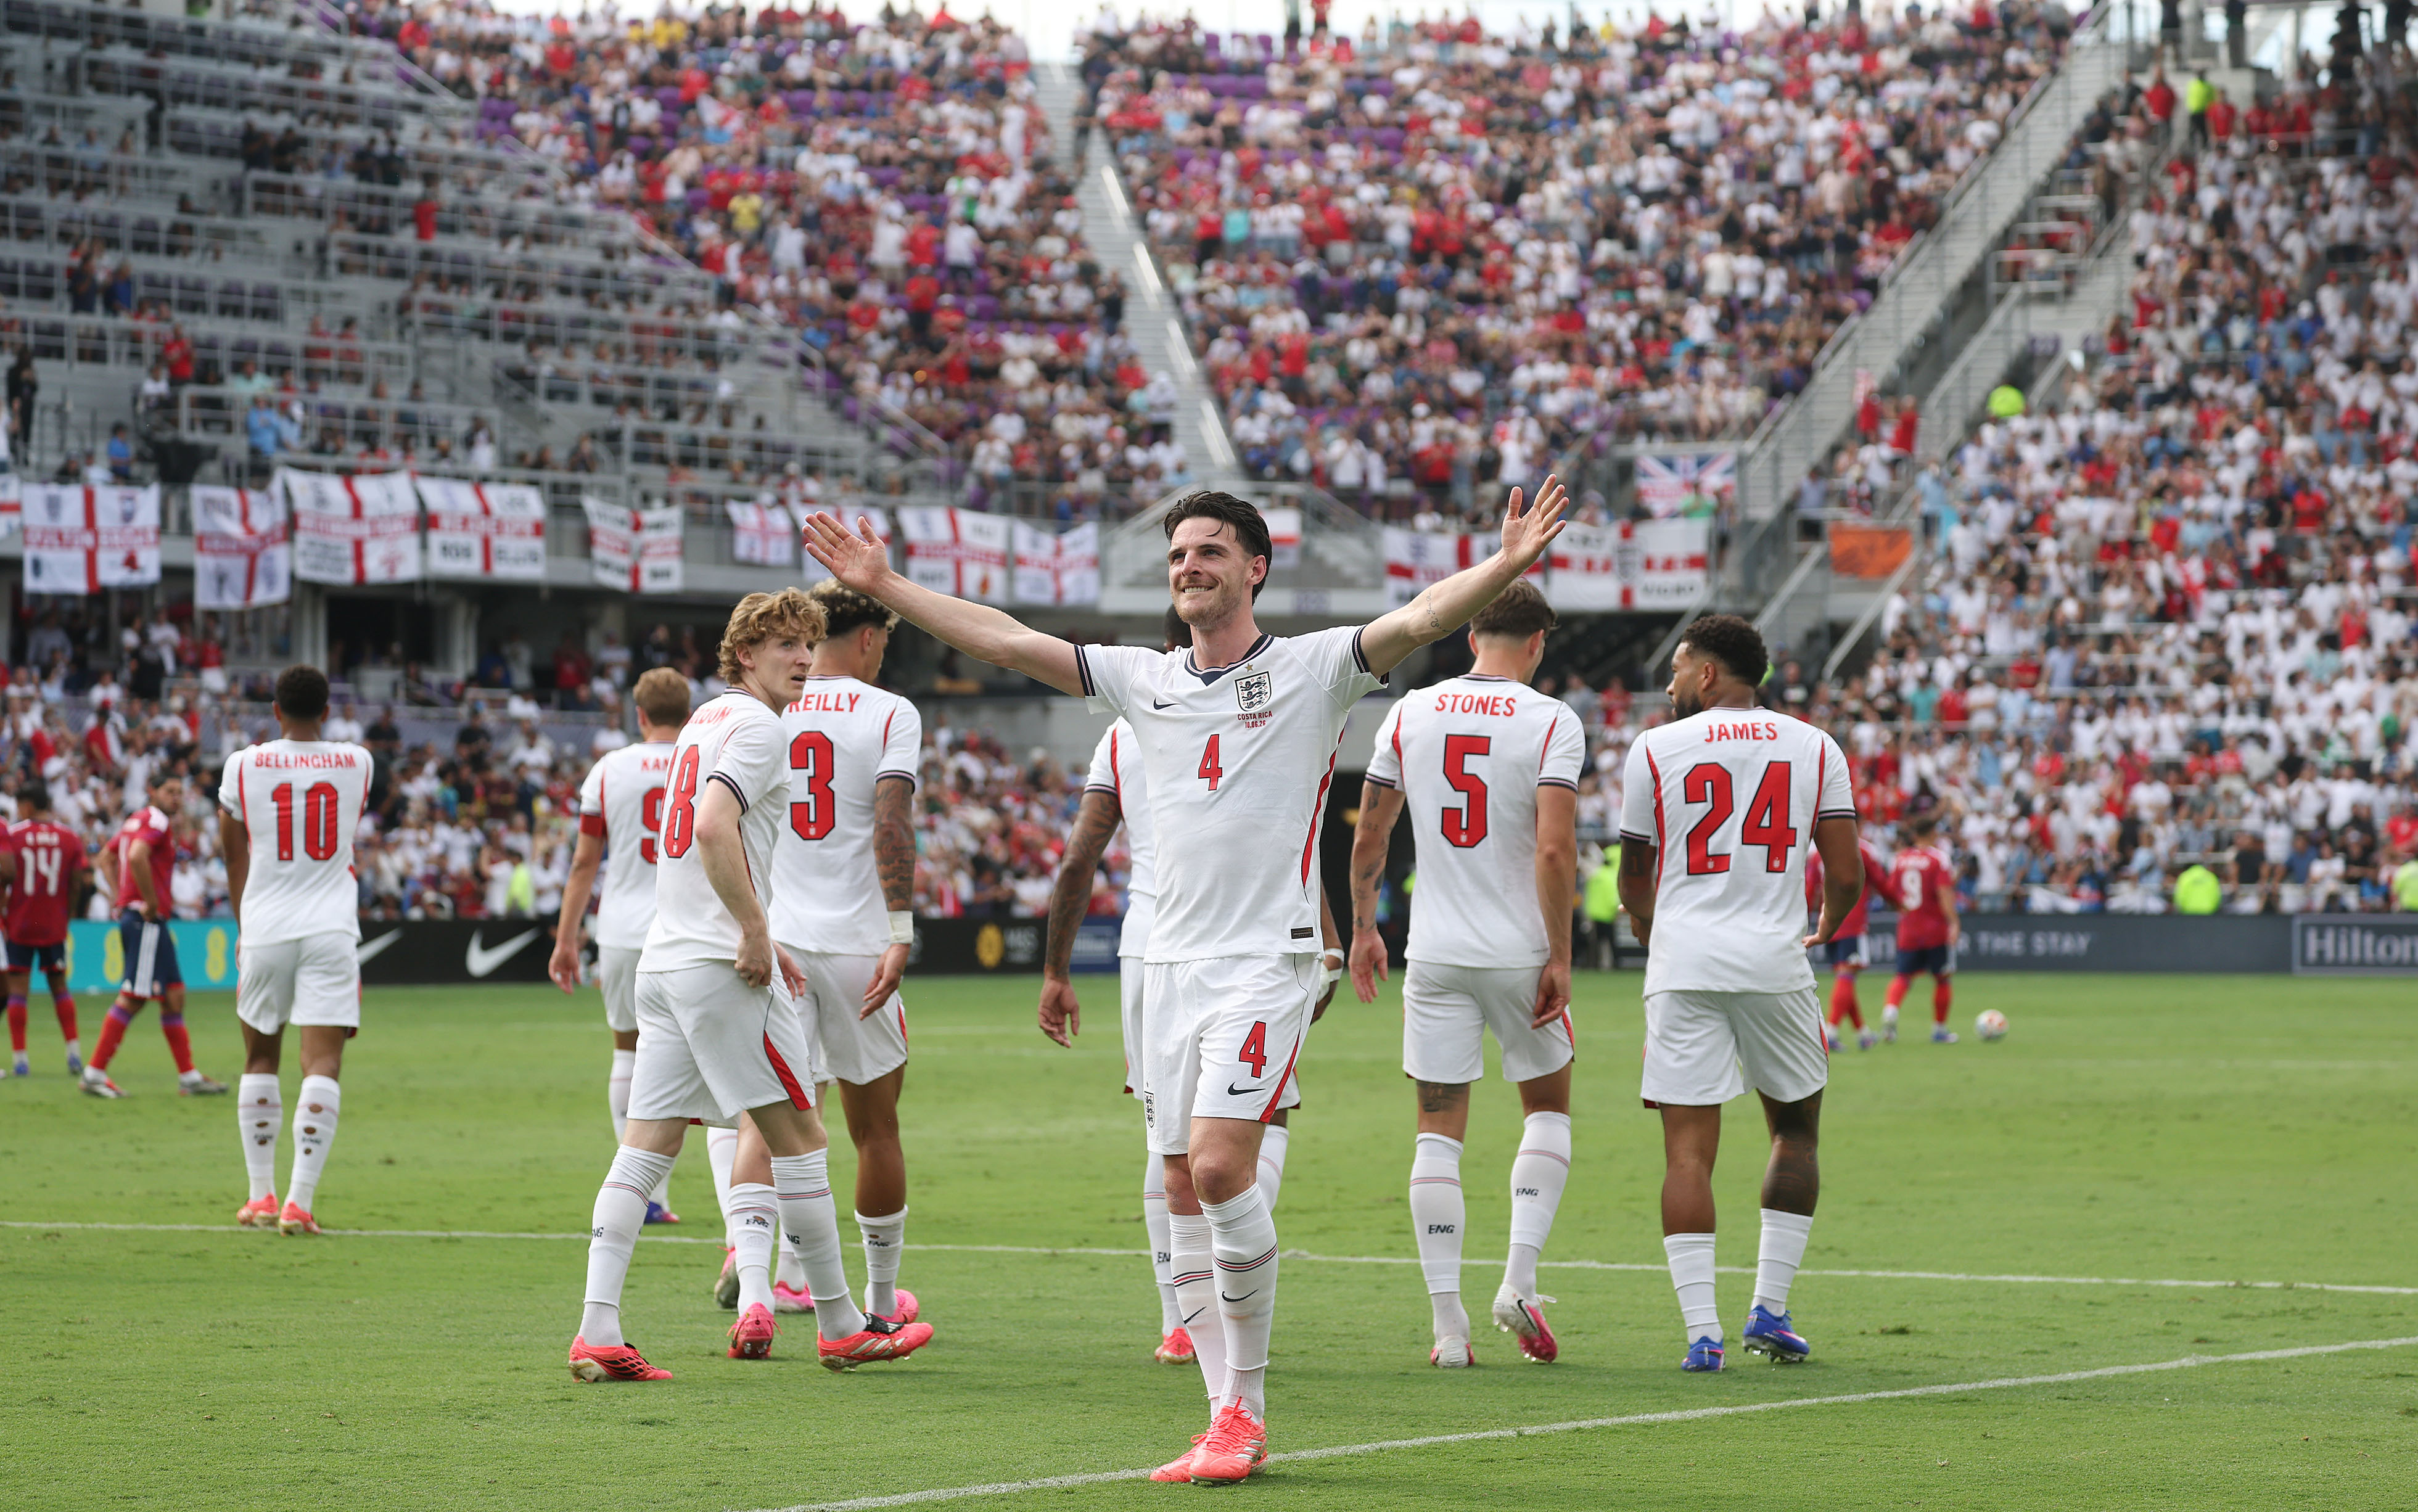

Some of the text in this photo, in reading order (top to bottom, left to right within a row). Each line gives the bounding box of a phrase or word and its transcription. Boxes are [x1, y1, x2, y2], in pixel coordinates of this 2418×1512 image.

[1258, 710, 1273, 719] RICA
[1435, 694, 1516, 717] STONES
[1244, 720, 1267, 728] 10.06.26
[1705, 722, 1778, 743] JAMES
[254, 752, 356, 769] BELLINGHAM
[641, 758, 669, 772] KAN
[1198, 734, 1223, 791] 4
[790, 731, 834, 840] 3
[1441, 734, 1491, 848] 5
[272, 782, 338, 861] 10
[1684, 761, 1797, 875] 24
[21, 847, 62, 896] 14
[1901, 870, 1923, 911] 9
[1977, 930, 2025, 956] THE
[2031, 930, 2091, 956] STAY
[1239, 1021, 1267, 1079] 4
[1516, 1188, 1539, 1197] ENG
[592, 1226, 604, 1238] NG
[785, 1232, 800, 1244] NG
[1428, 1224, 1455, 1234] ENG
[1158, 1251, 1171, 1263] EN
